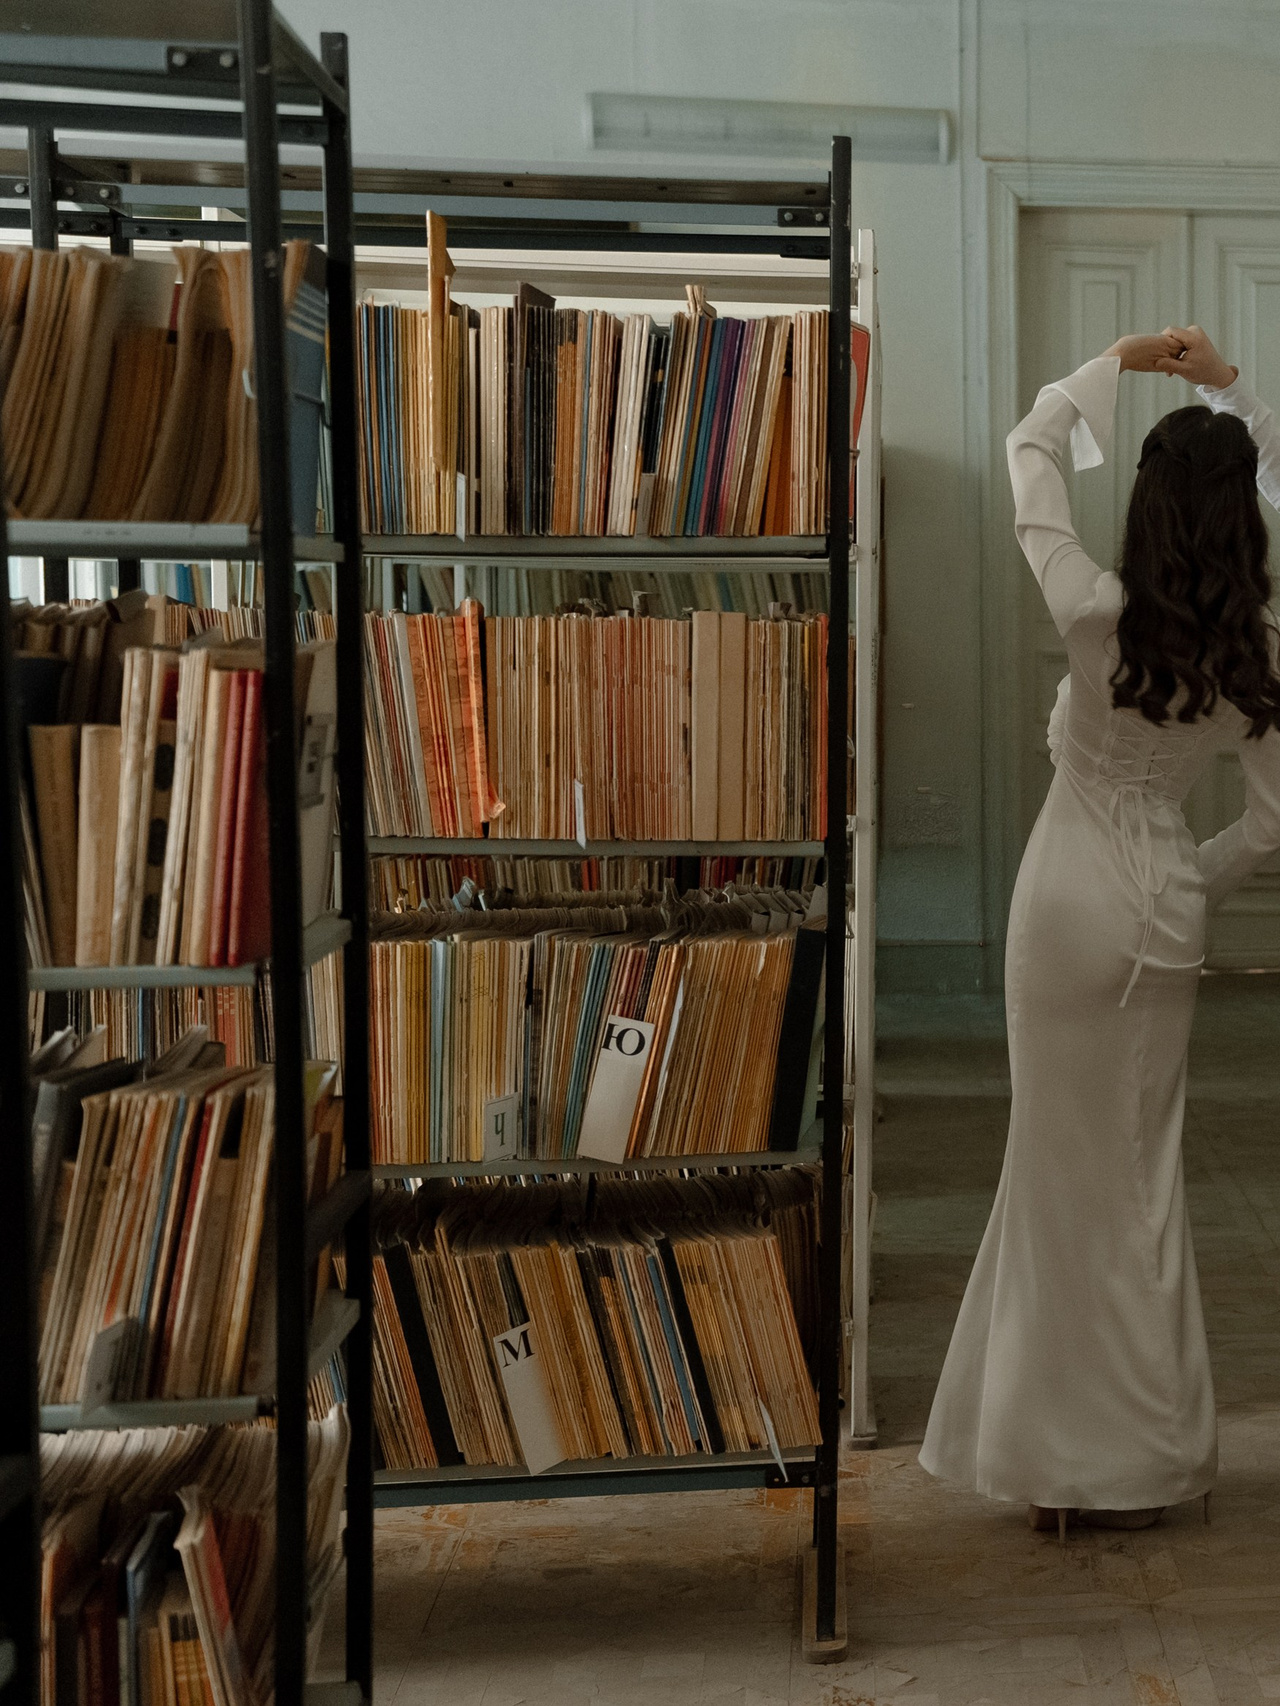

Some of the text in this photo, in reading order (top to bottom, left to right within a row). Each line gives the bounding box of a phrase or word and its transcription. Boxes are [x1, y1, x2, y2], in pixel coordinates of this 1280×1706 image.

[600, 1023, 647, 1057] Ю
[493, 1112, 507, 1147] Ч
[497, 1327, 535, 1369] М
